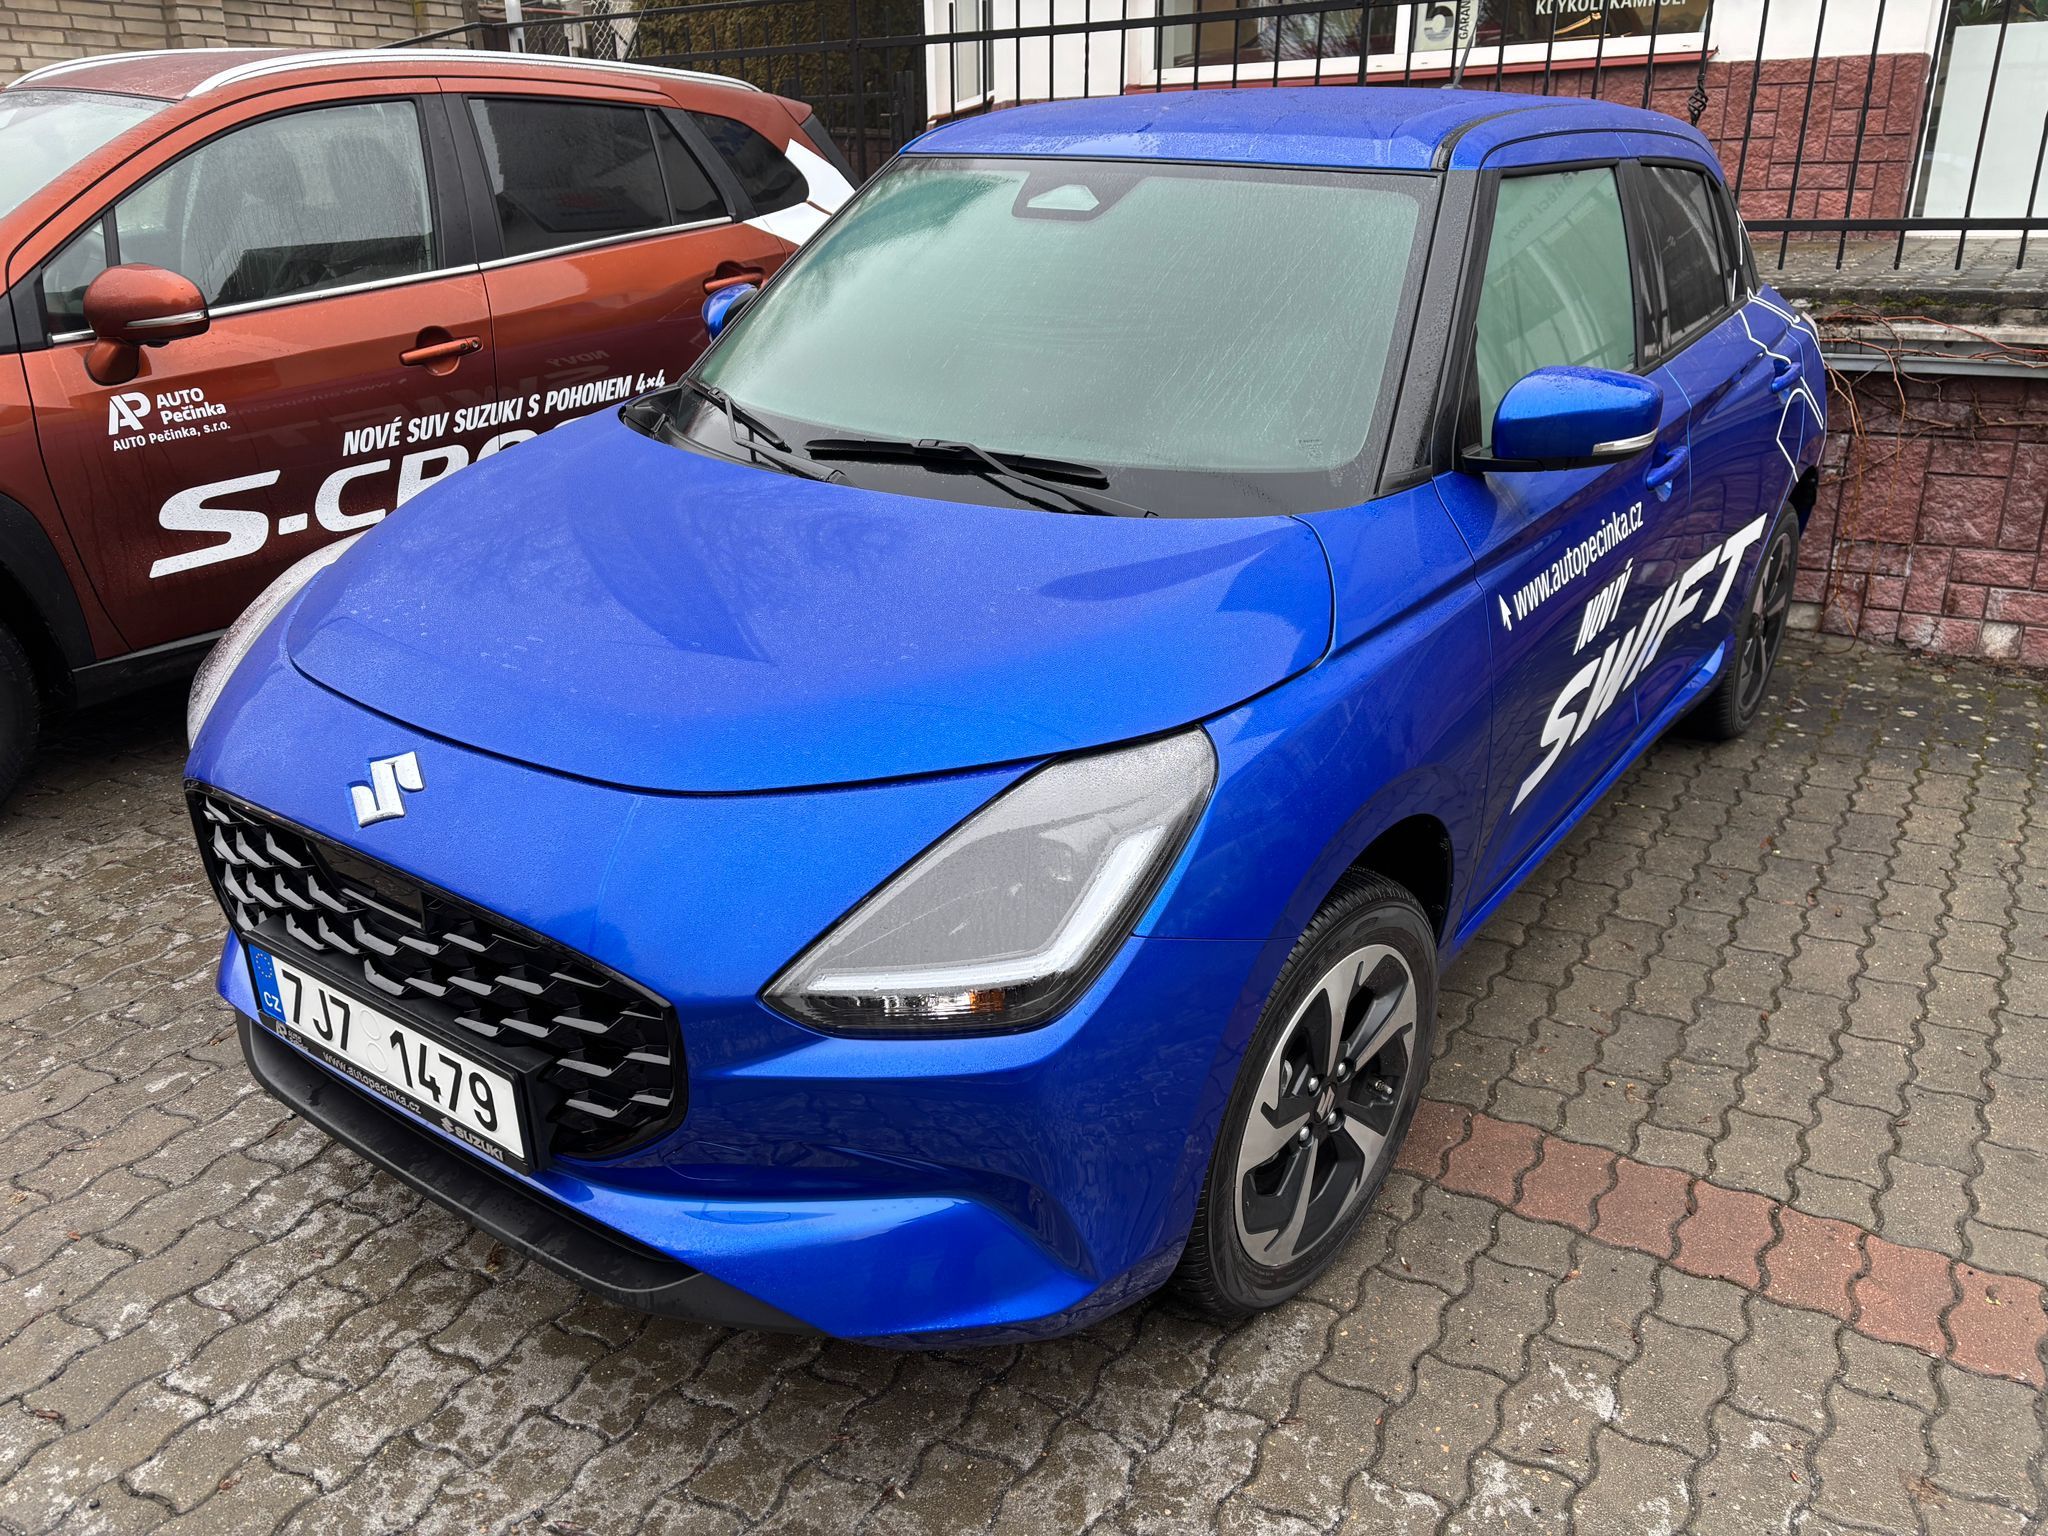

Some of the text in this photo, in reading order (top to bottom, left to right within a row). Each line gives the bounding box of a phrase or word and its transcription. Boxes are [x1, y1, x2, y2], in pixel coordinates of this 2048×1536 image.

[157, 388, 204, 408] AUTO
[160, 402, 227, 424] Pečinka
[342, 416, 402, 456] NOVÉ
[407, 412, 450, 442] SUV
[453, 397, 524, 433] SUZUKI
[527, 394, 541, 418] S
[544, 373, 632, 415] POHONEM
[113, 421, 231, 452] AUTO Pečinka, s.r.o.
[1513, 502, 1644, 621] www.autopecinka.cz
[1509, 513, 1768, 815] SWIFT
[264, 991, 281, 1013] CZ
[282, 968, 498, 1133] 7J7 1479
[323, 1052, 421, 1114] www.autopecinka.cz
[455, 1126, 503, 1161] SUZUKI
